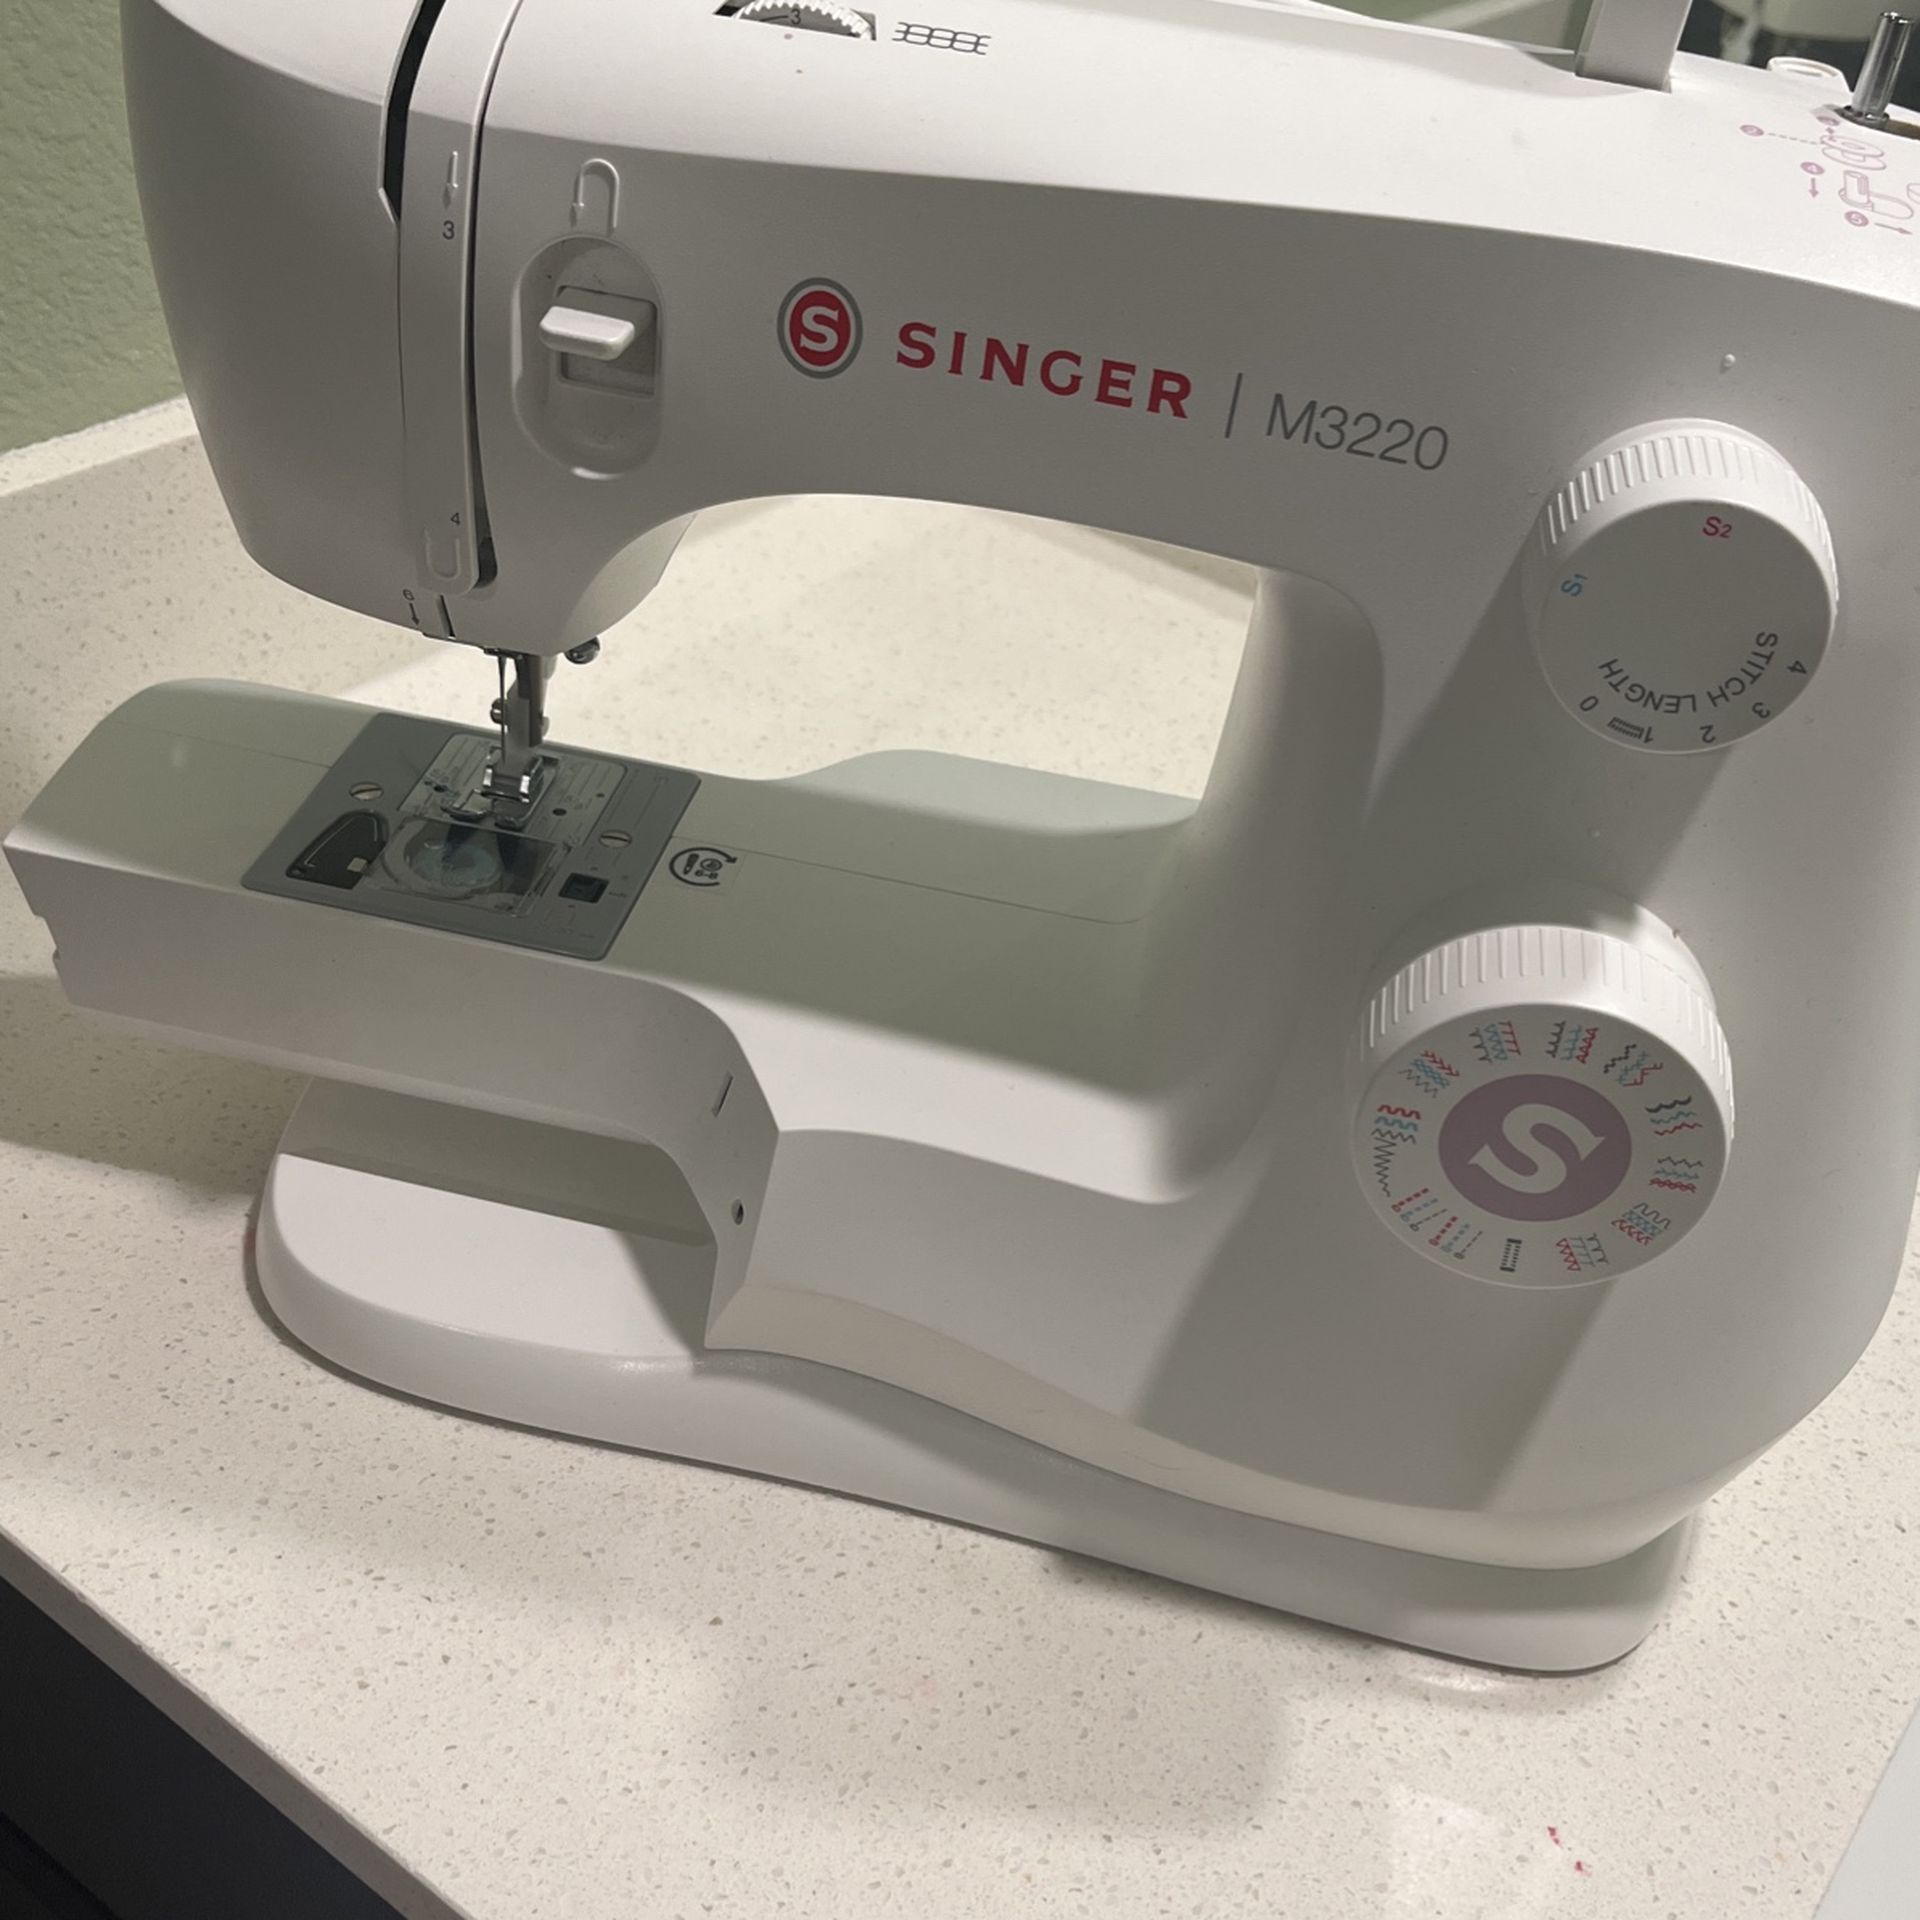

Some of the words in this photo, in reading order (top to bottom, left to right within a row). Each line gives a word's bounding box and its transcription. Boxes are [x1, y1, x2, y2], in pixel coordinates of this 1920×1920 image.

[790, 8, 801, 25] 3
[442, 220, 455, 240] 3
[896, 322, 1193, 419] SINGER
[1266, 393, 1449, 471] M3220
[450, 512, 461, 526] 4
[1702, 516, 1733, 538] S2
[1560, 573, 1588, 597] S1
[1706, 631, 1779, 708] STITCH
[1786, 660, 1808, 675] 4
[1598, 658, 1697, 714] LENGTH
[1579, 695, 1599, 712] 0
[1752, 702, 1771, 719] 3
[1643, 726, 1654, 744] 1
[1700, 725, 1716, 744] 2
[1467, 1103, 1606, 1194] S
